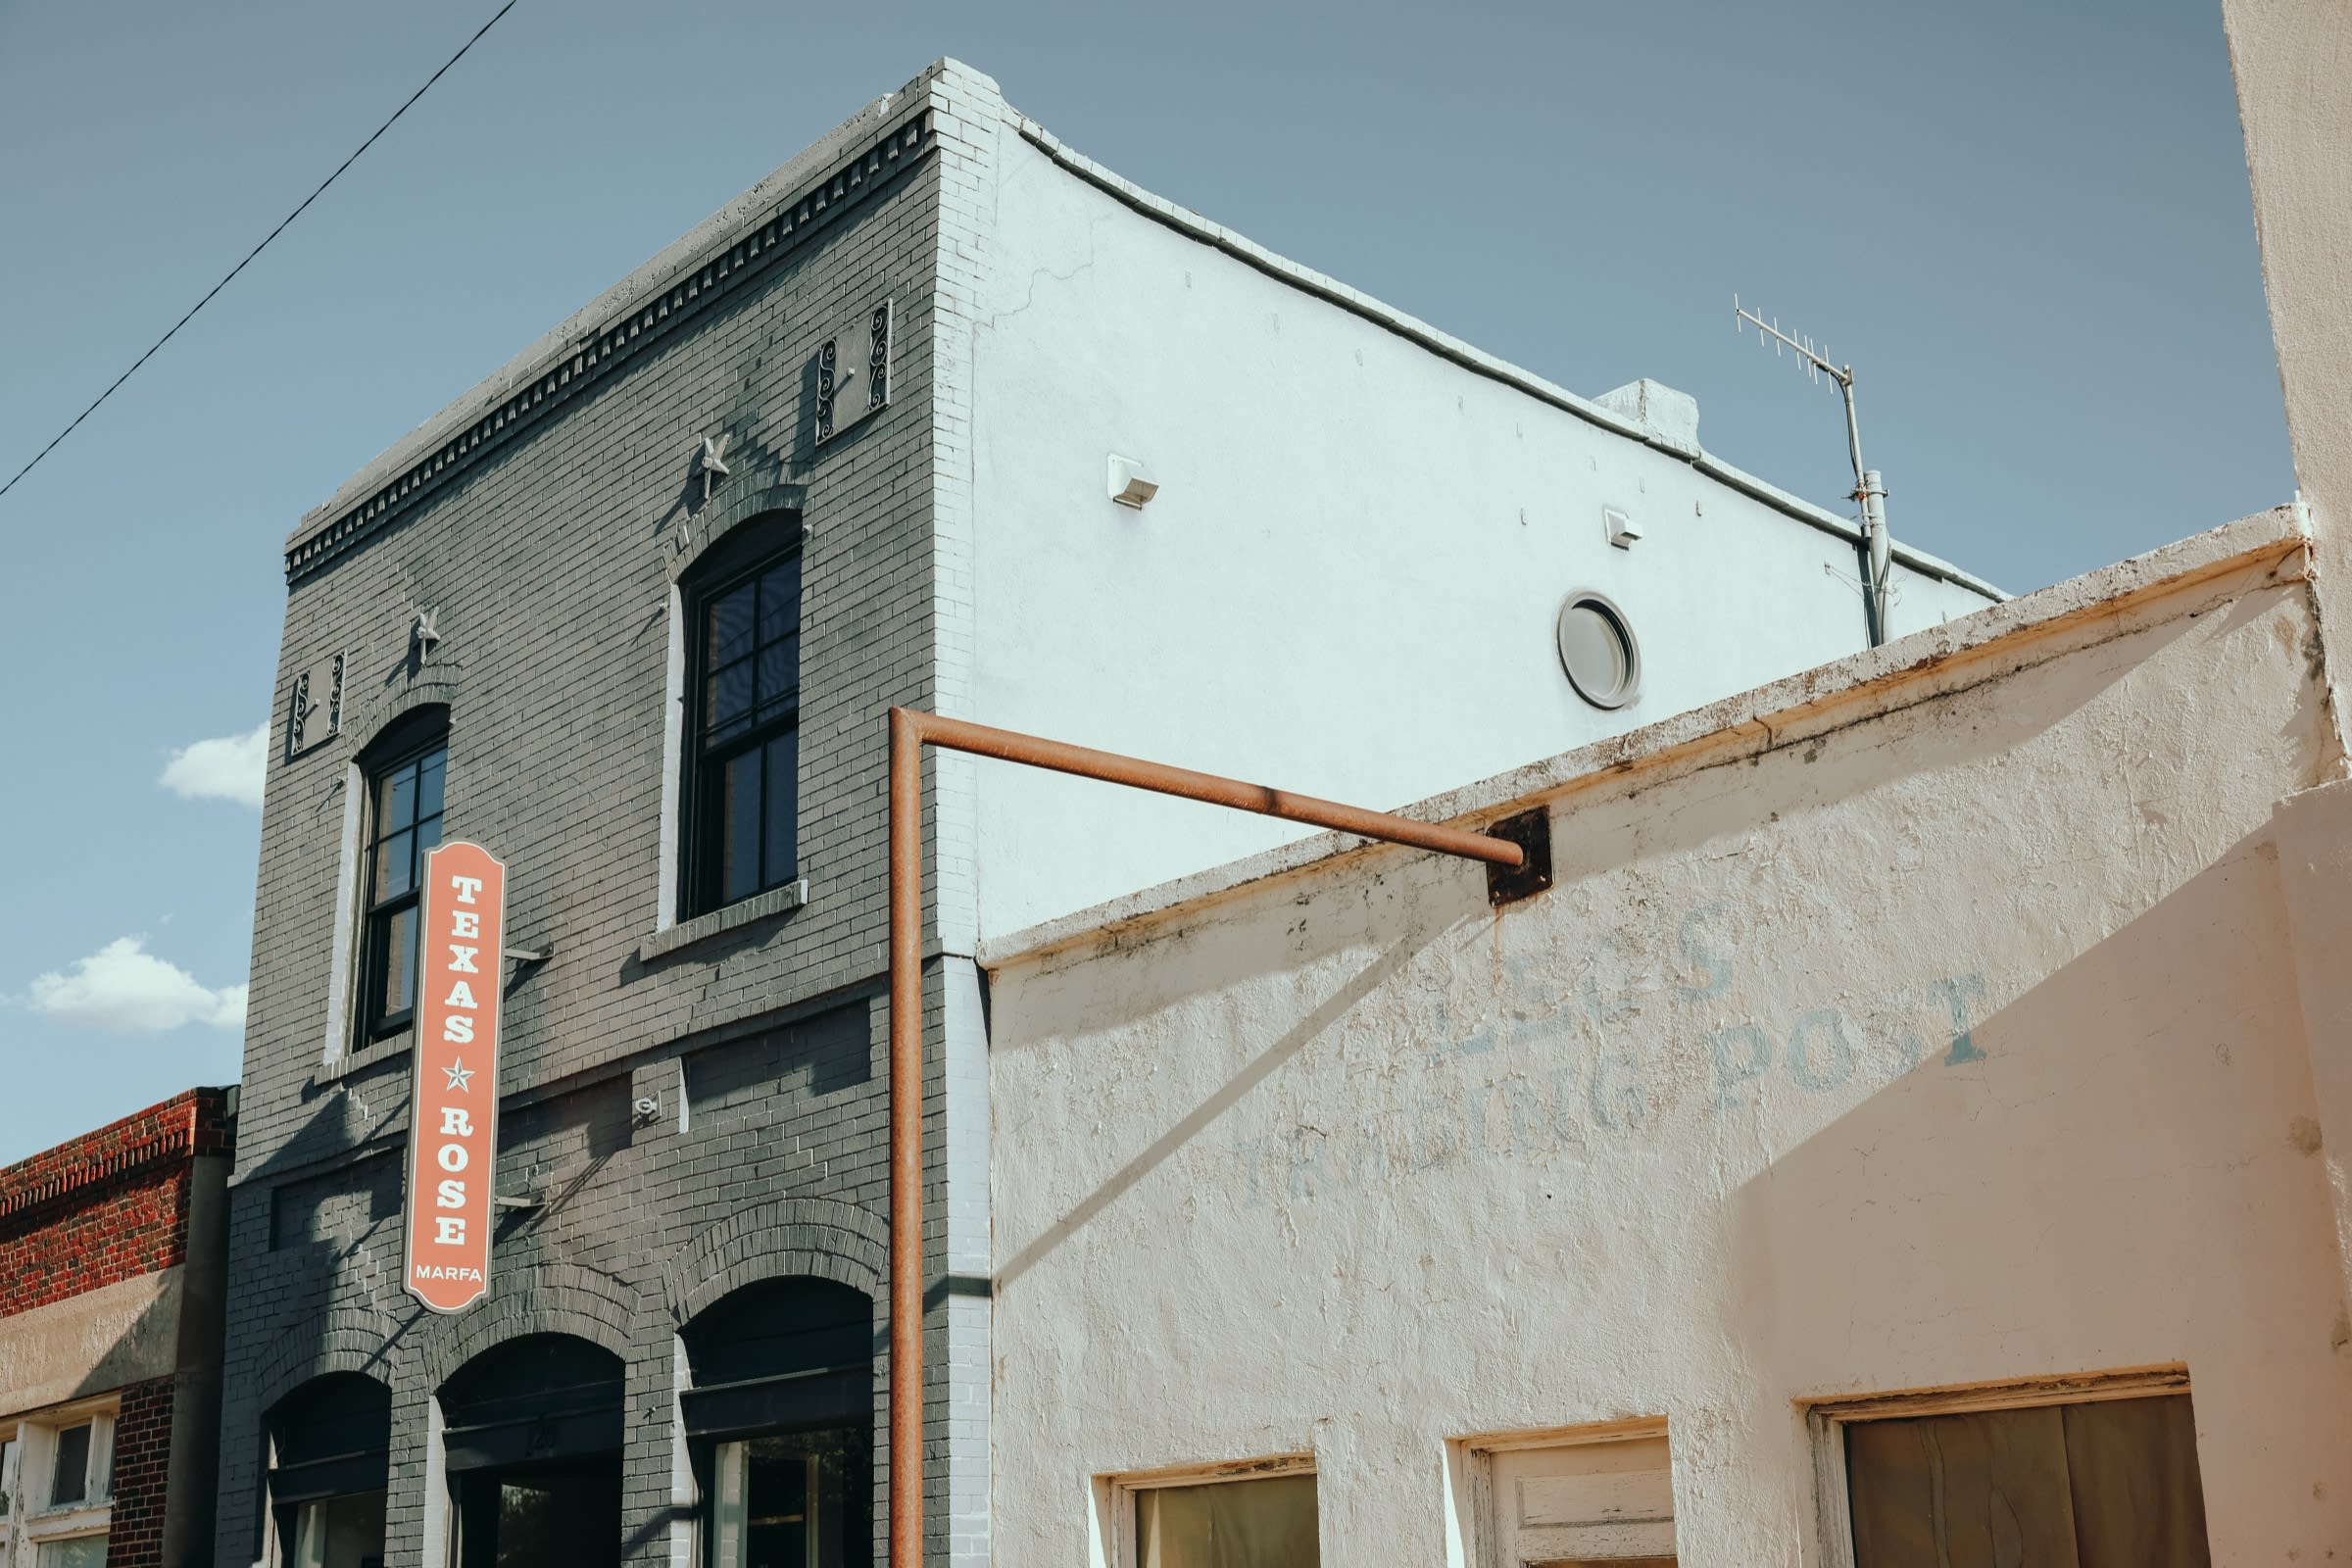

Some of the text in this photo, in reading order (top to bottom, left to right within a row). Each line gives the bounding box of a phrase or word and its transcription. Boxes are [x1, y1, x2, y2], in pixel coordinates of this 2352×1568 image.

[434, 875, 482, 1246] TEXAS ROSE
[416, 1264, 482, 1283] MARFA
